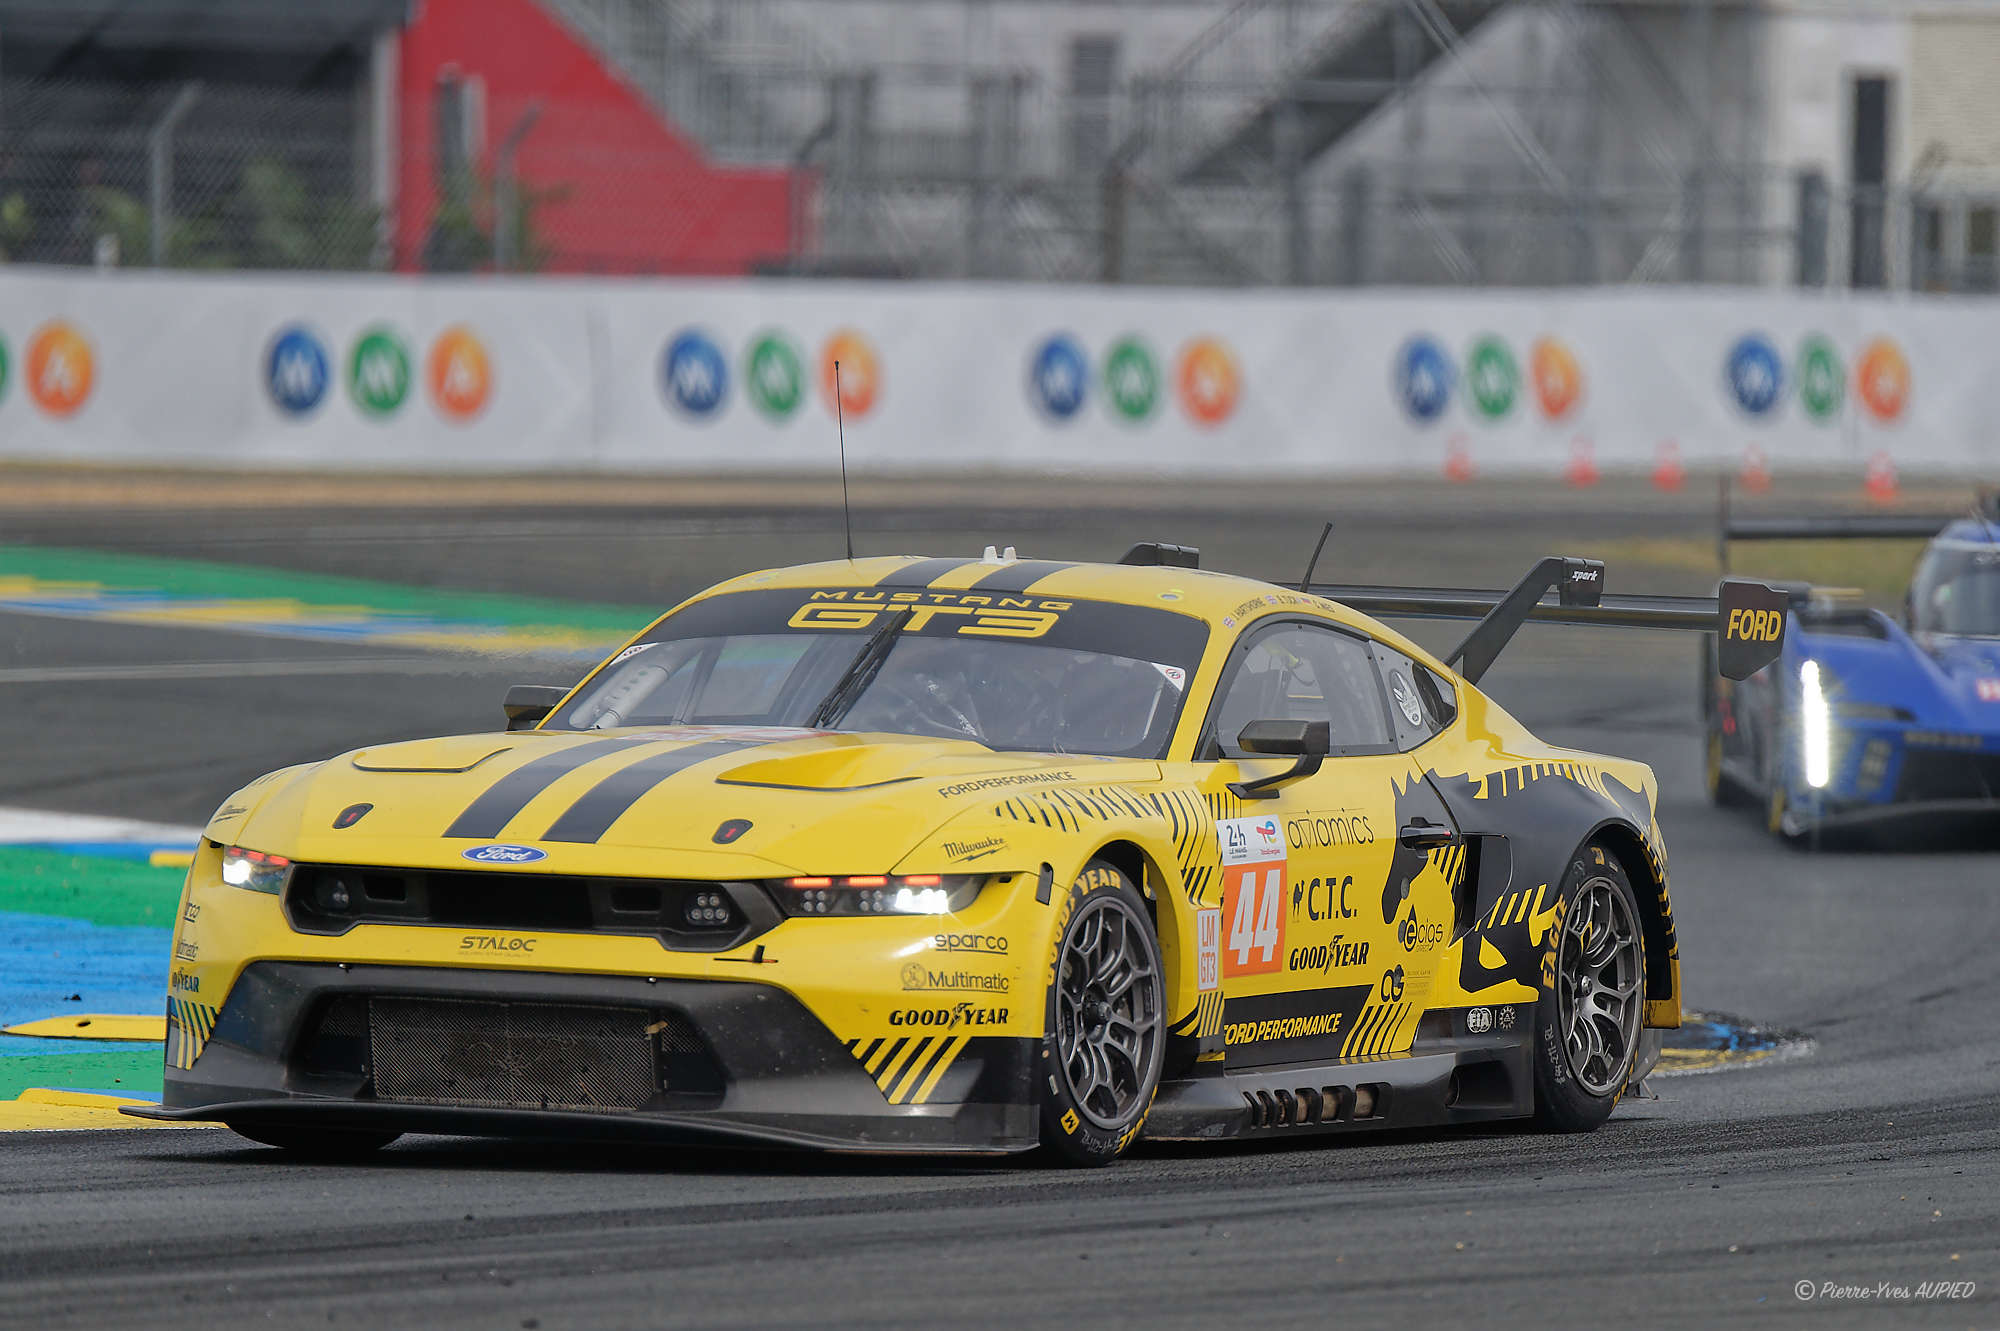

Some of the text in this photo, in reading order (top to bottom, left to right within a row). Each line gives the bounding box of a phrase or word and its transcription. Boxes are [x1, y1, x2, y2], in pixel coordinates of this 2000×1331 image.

[1572, 570, 1598, 581] spark
[810, 591, 1073, 611] MUSTANG
[787, 602, 1060, 638] GT3
[1727, 609, 1782, 641] FORD
[474, 845, 534, 862] Ford
[1308, 875, 1358, 921] C.T.C.
[1229, 870, 1280, 965] 44
[460, 936, 537, 952] STALOC
[935, 934, 1008, 952] sparco
[1202, 915, 1215, 947] LM
[1543, 893, 1567, 990] EAGLE
[928, 971, 1008, 990] Multimatic
[1201, 952, 1215, 983] GT3
[1469, 1010, 1490, 1031] FIA
